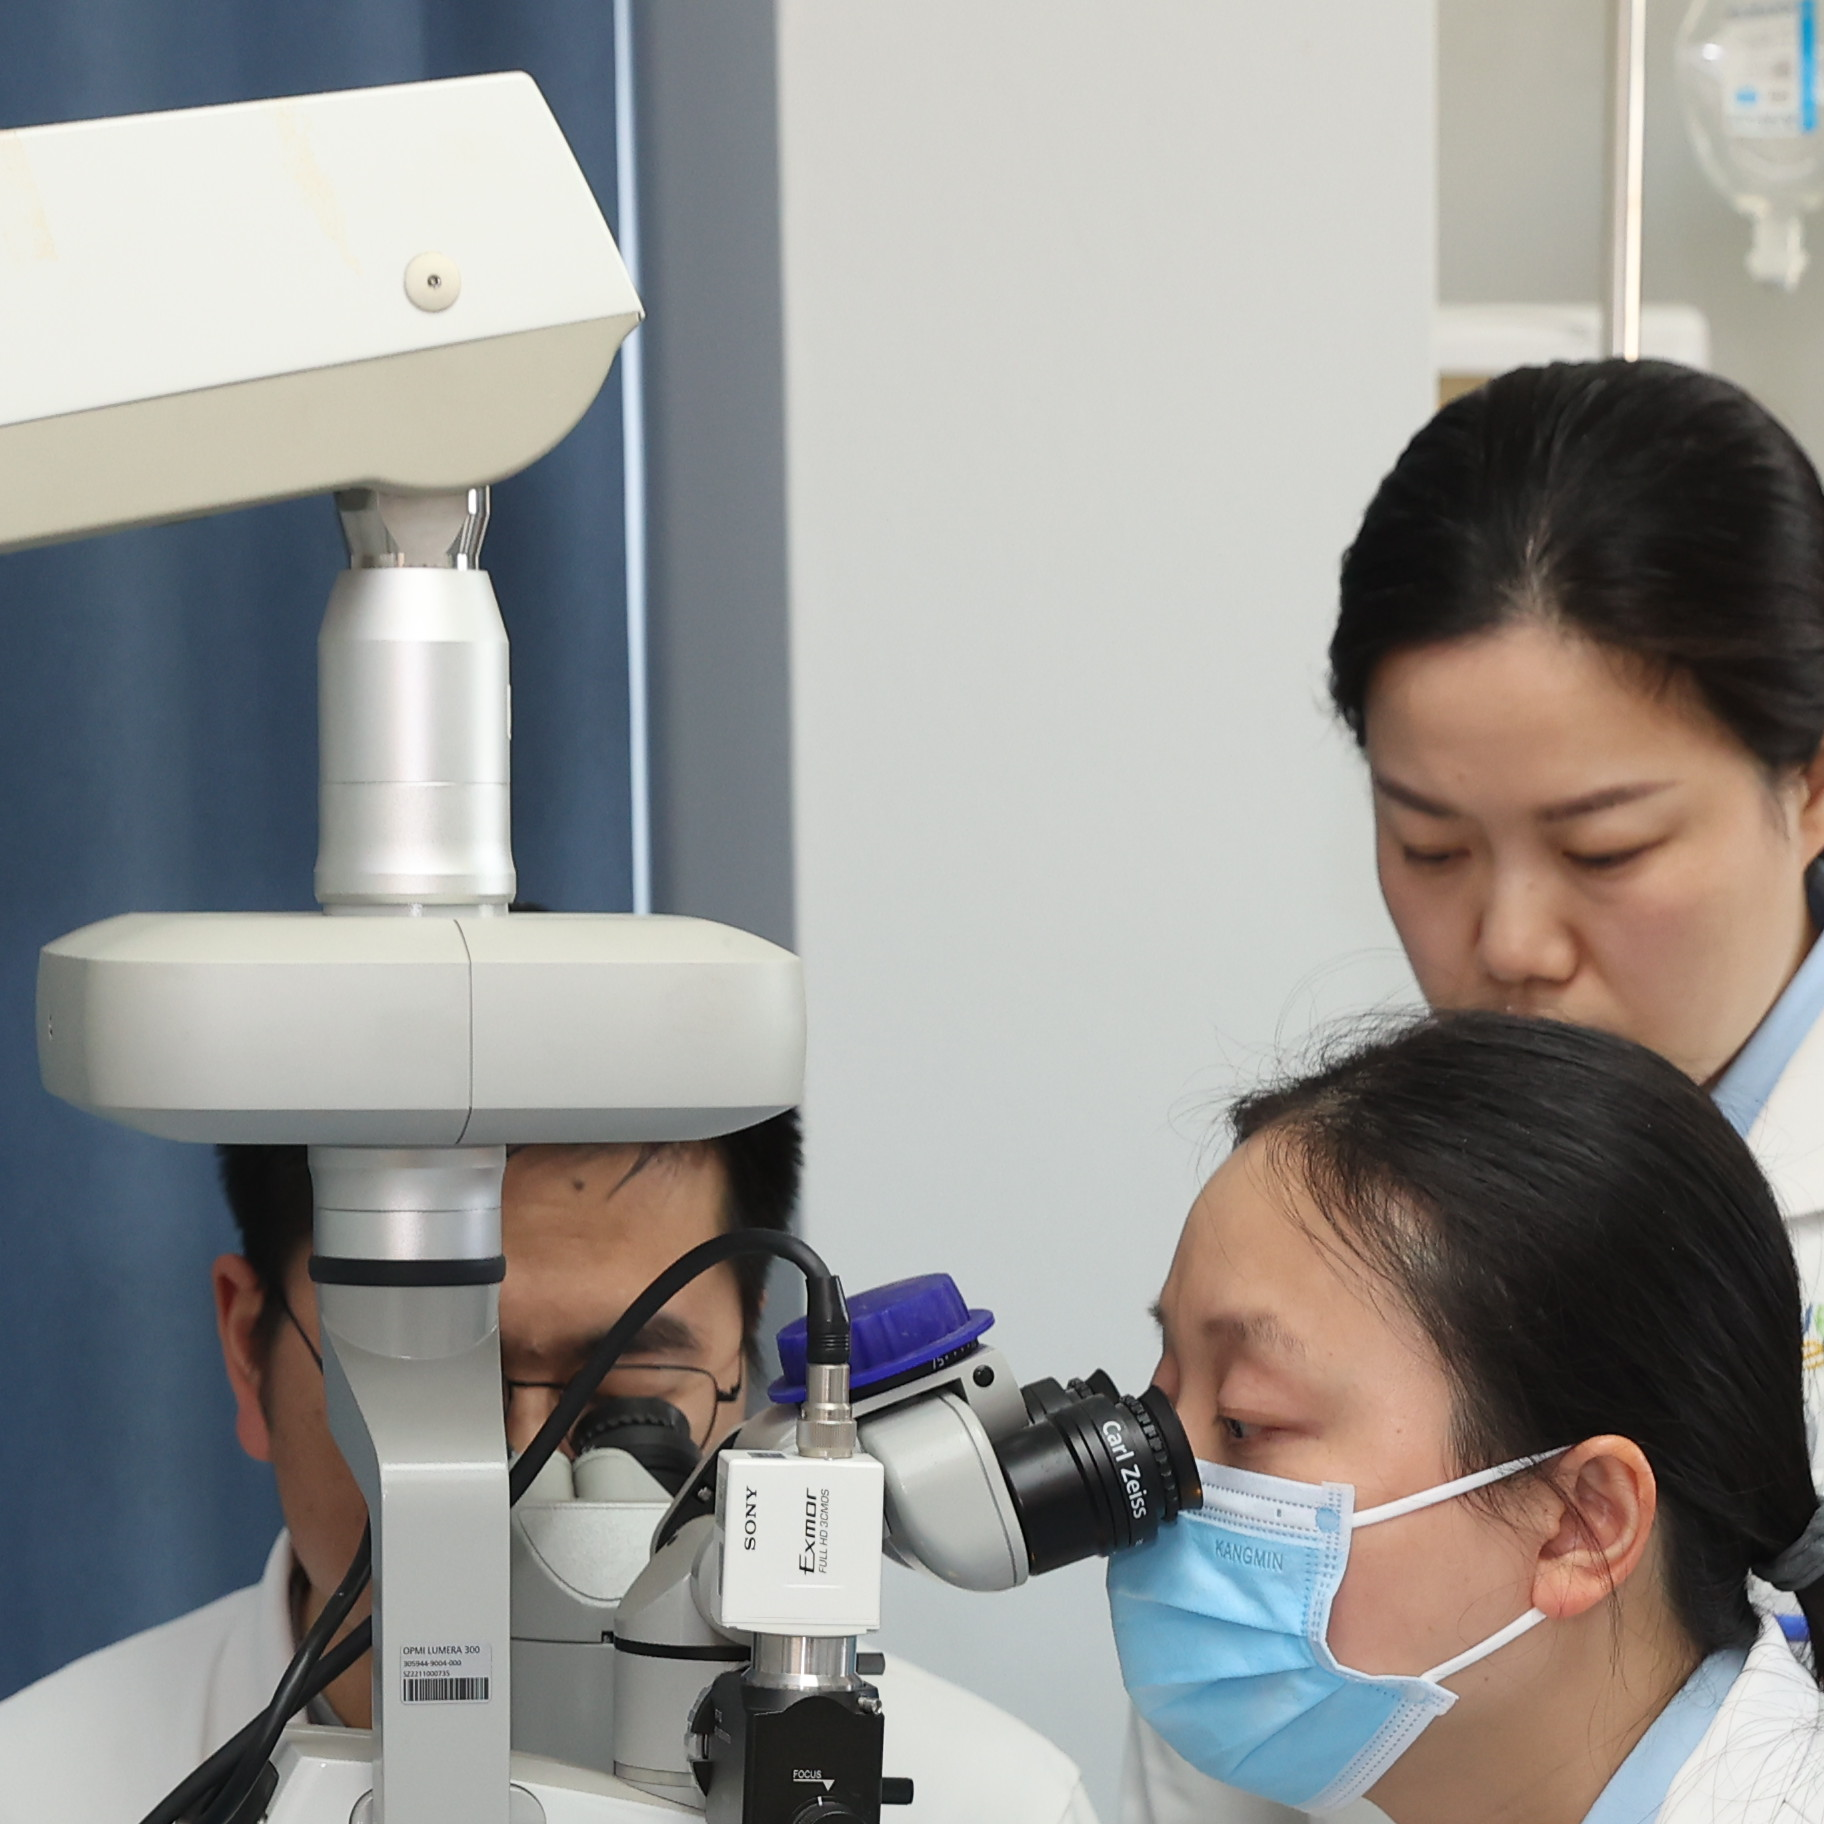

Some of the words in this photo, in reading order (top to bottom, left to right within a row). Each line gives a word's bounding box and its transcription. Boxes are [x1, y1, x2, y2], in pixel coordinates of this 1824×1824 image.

[1103, 1420, 1135, 1462] Carl
[1121, 1464, 1147, 1519] Zeiss
[742, 1485, 757, 1551] SONY
[820, 1488, 830, 1528] 3CMOS
[799, 1487, 817, 1575] Exmor
[819, 1529, 828, 1546] HD
[818, 1549, 828, 1574] FULL
[1215, 1539, 1283, 1572] KANGMIN
[403, 1645, 426, 1655] OPMI
[428, 1645, 462, 1655] LUMERA
[465, 1645, 481, 1654] 300
[792, 1769, 822, 1779] FOCUS
